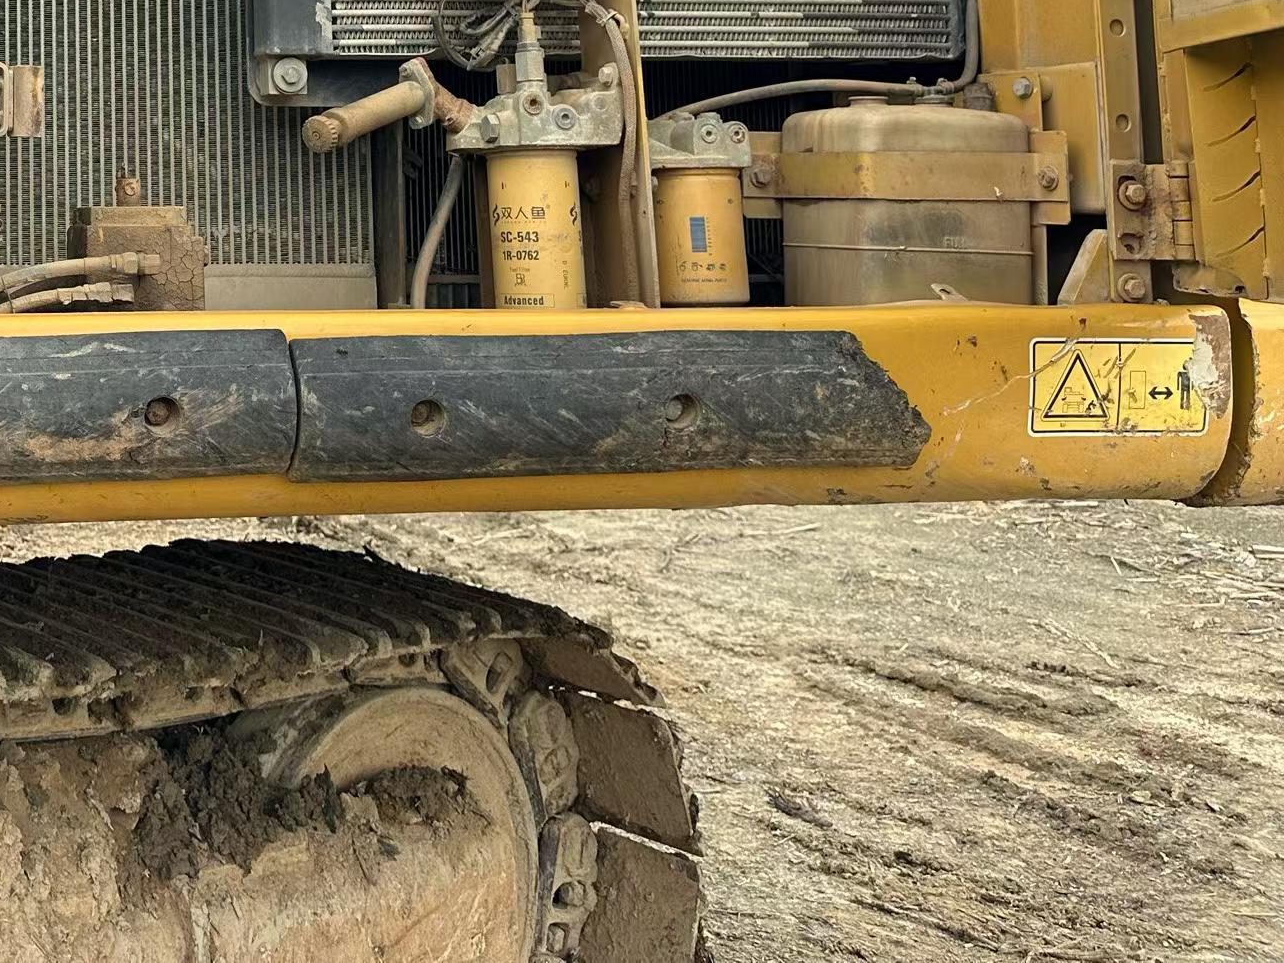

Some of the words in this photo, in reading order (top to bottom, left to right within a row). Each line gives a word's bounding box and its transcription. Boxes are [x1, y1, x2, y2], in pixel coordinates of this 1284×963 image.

[500, 206, 546, 220] 双人鱼
[500, 231, 539, 243] SC-543
[502, 250, 540, 261] 1R-0762
[504, 295, 544, 306] Advanced
